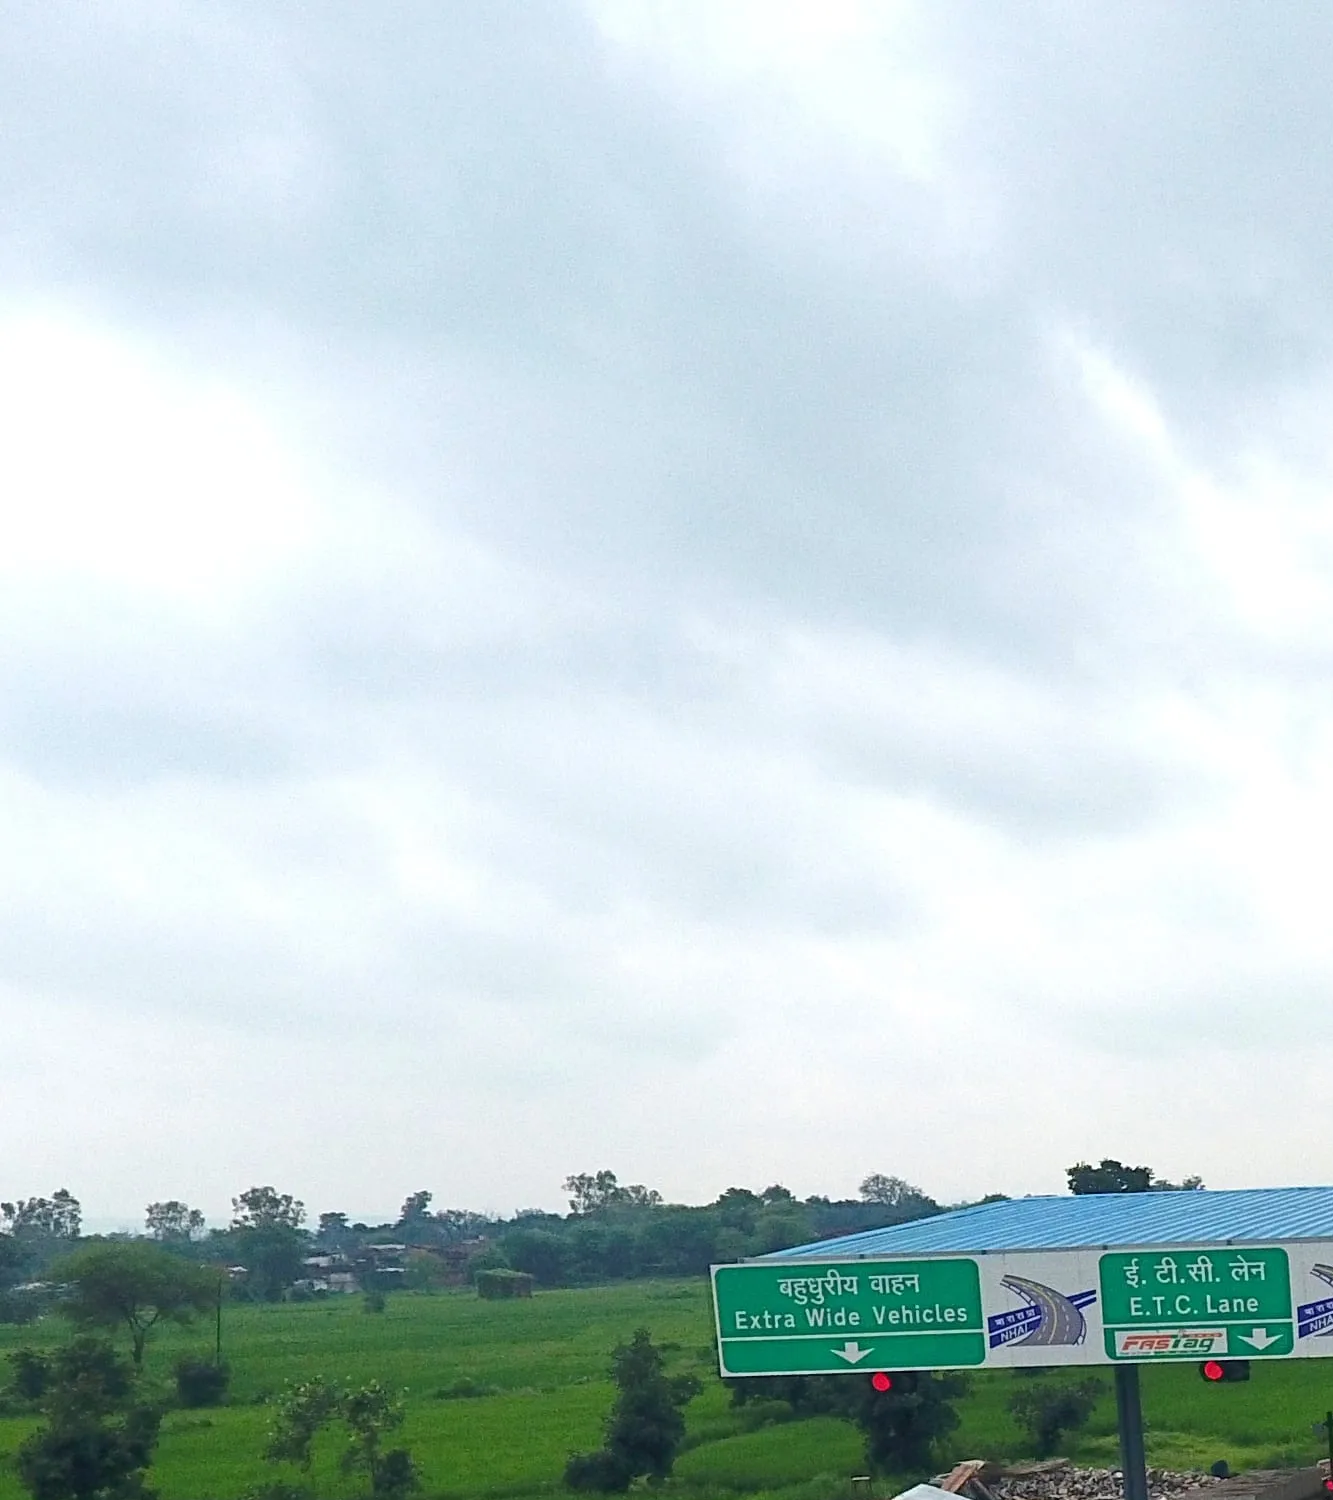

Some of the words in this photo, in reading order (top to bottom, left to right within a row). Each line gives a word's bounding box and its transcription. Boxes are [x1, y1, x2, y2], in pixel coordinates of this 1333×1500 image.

[1228, 1255, 1266, 1281] लेन
[776, 1268, 858, 1305] बहुधुरीय
[868, 1273, 920, 1296] वाहन
[735, 1310, 796, 1330] Extra
[805, 1307, 861, 1327] Wide
[872, 1304, 967, 1325] Vehicles
[1130, 1295, 1199, 1317] E.T.C.
[1206, 1294, 1259, 1314] Lane
[1000, 1323, 1029, 1342] NHAI
